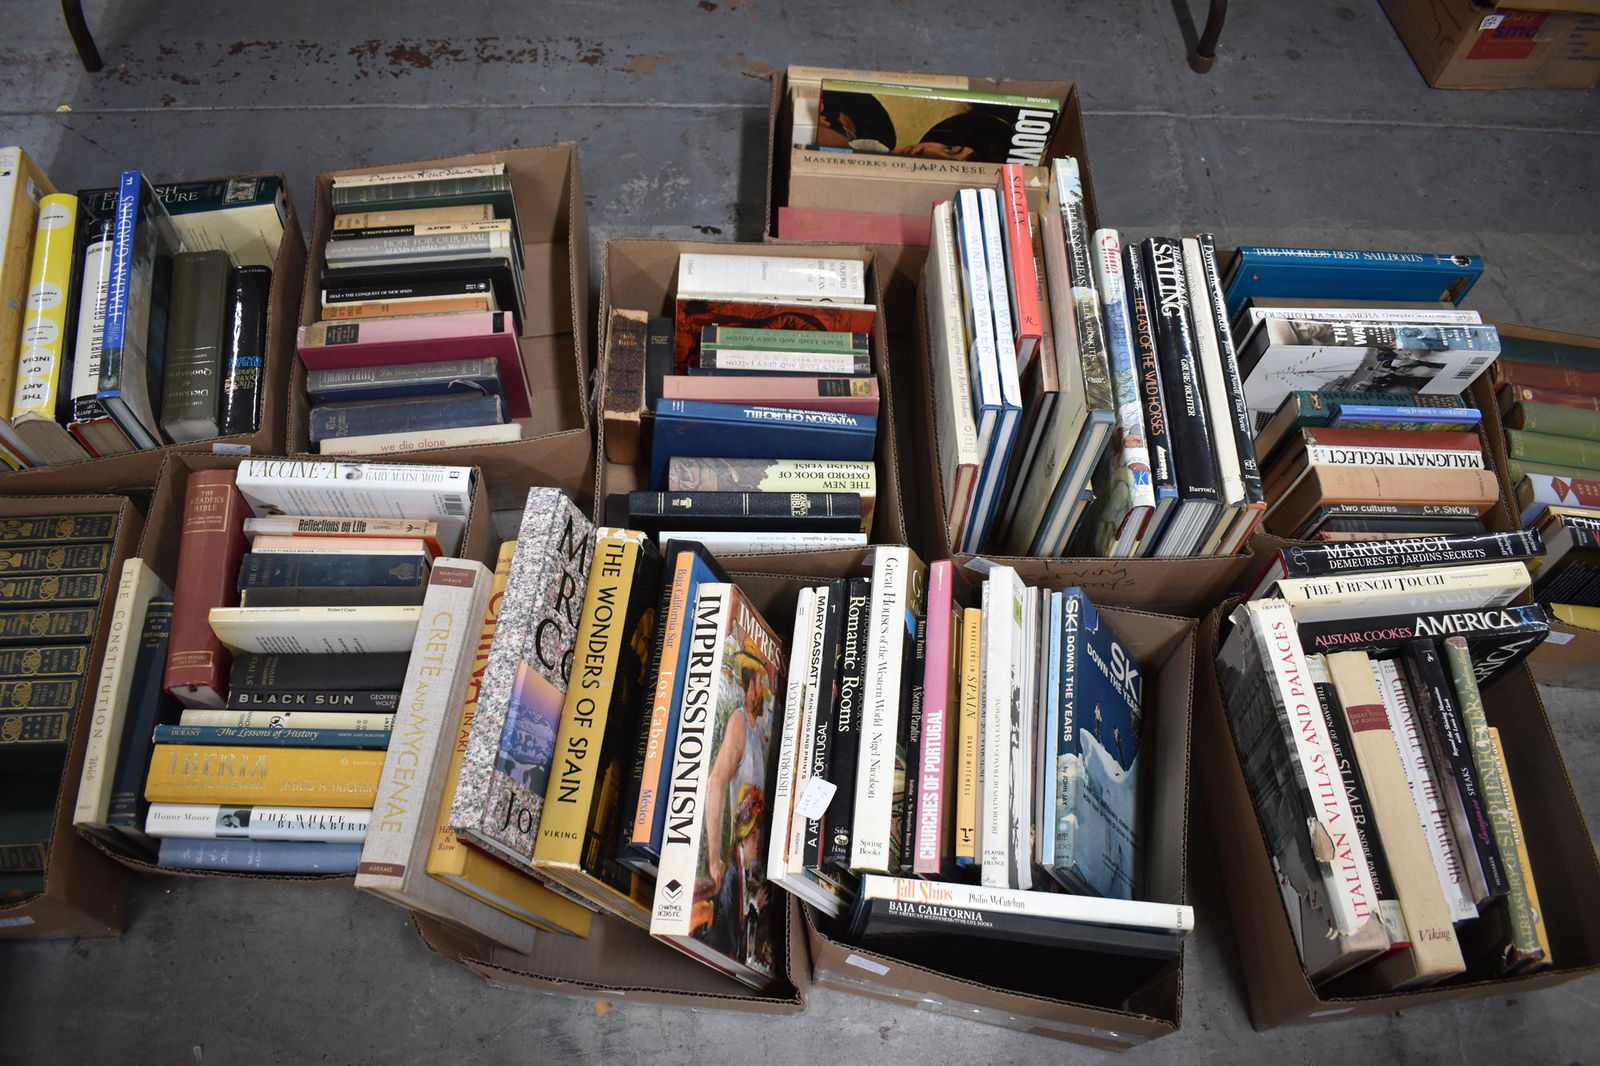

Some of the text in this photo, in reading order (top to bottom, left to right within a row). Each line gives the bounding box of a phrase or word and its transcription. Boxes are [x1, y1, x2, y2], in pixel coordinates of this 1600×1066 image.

[804, 156, 888, 167] MASTERWORKS
[910, 163, 986, 175] JAPANESE
[1012, 175, 1025, 226] SICILY
[384, 232, 487, 248] HOPE FOR OUR TIME
[108, 194, 134, 318] ITALIAN GARDENS
[1254, 247, 1281, 257] THE
[1332, 250, 1360, 260] BEST
[1363, 251, 1424, 262] SAILBOATS
[1151, 242, 1181, 318] SAILING
[971, 236, 992, 354] WIND AND WATER
[992, 236, 1012, 354] WIND AND WATER
[1331, 321, 1348, 343] THE
[1349, 321, 1367, 346] WAR
[22, 356, 51, 365] INDIA
[26, 366, 42, 374] OF
[1134, 296, 1165, 436] THE LAST OF THE WILD HORSES
[21, 383, 43, 391] ART
[22, 393, 42, 401] THE
[1180, 358, 1196, 417] GRUBE/RICHTER
[743, 409, 858, 426] WINSTON CHURCHILL
[380, 439, 446, 451] we die alone
[793, 463, 870, 471] ENGLISH VERSE
[1328, 450, 1480, 468] MALIGNANT NEGLECT
[365, 470, 445, 484] GARY MATSUMOTO
[777, 471, 870, 480] OXFORD BOOK OF
[823, 481, 871, 489] THE NEW
[190, 496, 225, 505] READER'S
[1189, 485, 1216, 493] Barron's
[791, 493, 800, 516] BIBLE
[1341, 504, 1361, 512] two
[1362, 504, 1398, 513] cultures
[298, 519, 340, 532] Reflections
[341, 520, 352, 533] on
[352, 520, 367, 534] Life
[1321, 536, 1453, 559] MARRAKECH
[1329, 548, 1487, 569] DEMEURES ET JARDINS SECRETS
[1300, 583, 1334, 600] THE
[1335, 578, 1393, 594] FRENCH
[1394, 574, 1445, 592] TOUCH
[666, 568, 688, 648] Baja California Sur
[814, 595, 827, 630] MARY
[1315, 632, 1363, 647] ALISTAIR
[1413, 610, 1519, 637] AMERICA
[872, 557, 900, 727] Great Houses of the Western World
[93, 570, 133, 739] THE CONSTITUTION
[809, 631, 823, 688] CASSATT
[839, 596, 867, 732] Romantic Rooms
[557, 543, 626, 803] THE WONDERS OF SPAIN
[1062, 598, 1080, 742] SKI DOWN THE YEARS
[239, 694, 354, 705] BLACK SUN
[910, 692, 922, 715] Second
[1316, 685, 1327, 703] THE
[647, 669, 673, 760] Los Cabos
[667, 593, 722, 849] IMPRESSIONISM
[805, 693, 815, 732] PAINTINGS
[964, 622, 978, 797] TRAVELLERS IN SPAIN DAVID MITCHELL
[1321, 703, 1334, 729] DAWN
[1391, 677, 1425, 753] CHRONICLE
[171, 728, 201, 736] DURANT
[215, 727, 320, 740] The Lessons of History
[380, 610, 453, 834] CRETE AND MYCENAE
[909, 715, 922, 743] Paradise
[777, 681, 799, 800] HISTORIA DE PORTUGAL
[1328, 729, 1337, 741] OF
[1332, 741, 1343, 758] ART
[801, 750, 810, 780] PRINTS
[867, 732, 883, 799] Nigel Nicolson
[1270, 620, 1370, 919] ITALIAN VILLAS AND PALACES
[1416, 755, 1430, 771] OF
[919, 709, 944, 860] CHURCHES OF PORTUGAL
[1061, 766, 1069, 806] by JOHN JAY
[1421, 778, 1440, 804] THE
[1461, 767, 1476, 796] SPEAKS
[153, 811, 211, 822] Honor Moore
[258, 812, 345, 824] THE WHITE
[638, 789, 653, 825] México
[277, 820, 367, 832] BLACKBIRD
[543, 830, 579, 840] VIKING
[859, 839, 883, 849] Spring
[859, 846, 881, 856] Books
[1430, 807, 1464, 885] PHARAOHS
[1366, 860, 1384, 897] PARROT
[893, 878, 953, 904] Tall Ships
[889, 900, 984, 922] BAJA CALIFORNIA
[1417, 928, 1453, 943] Viking
